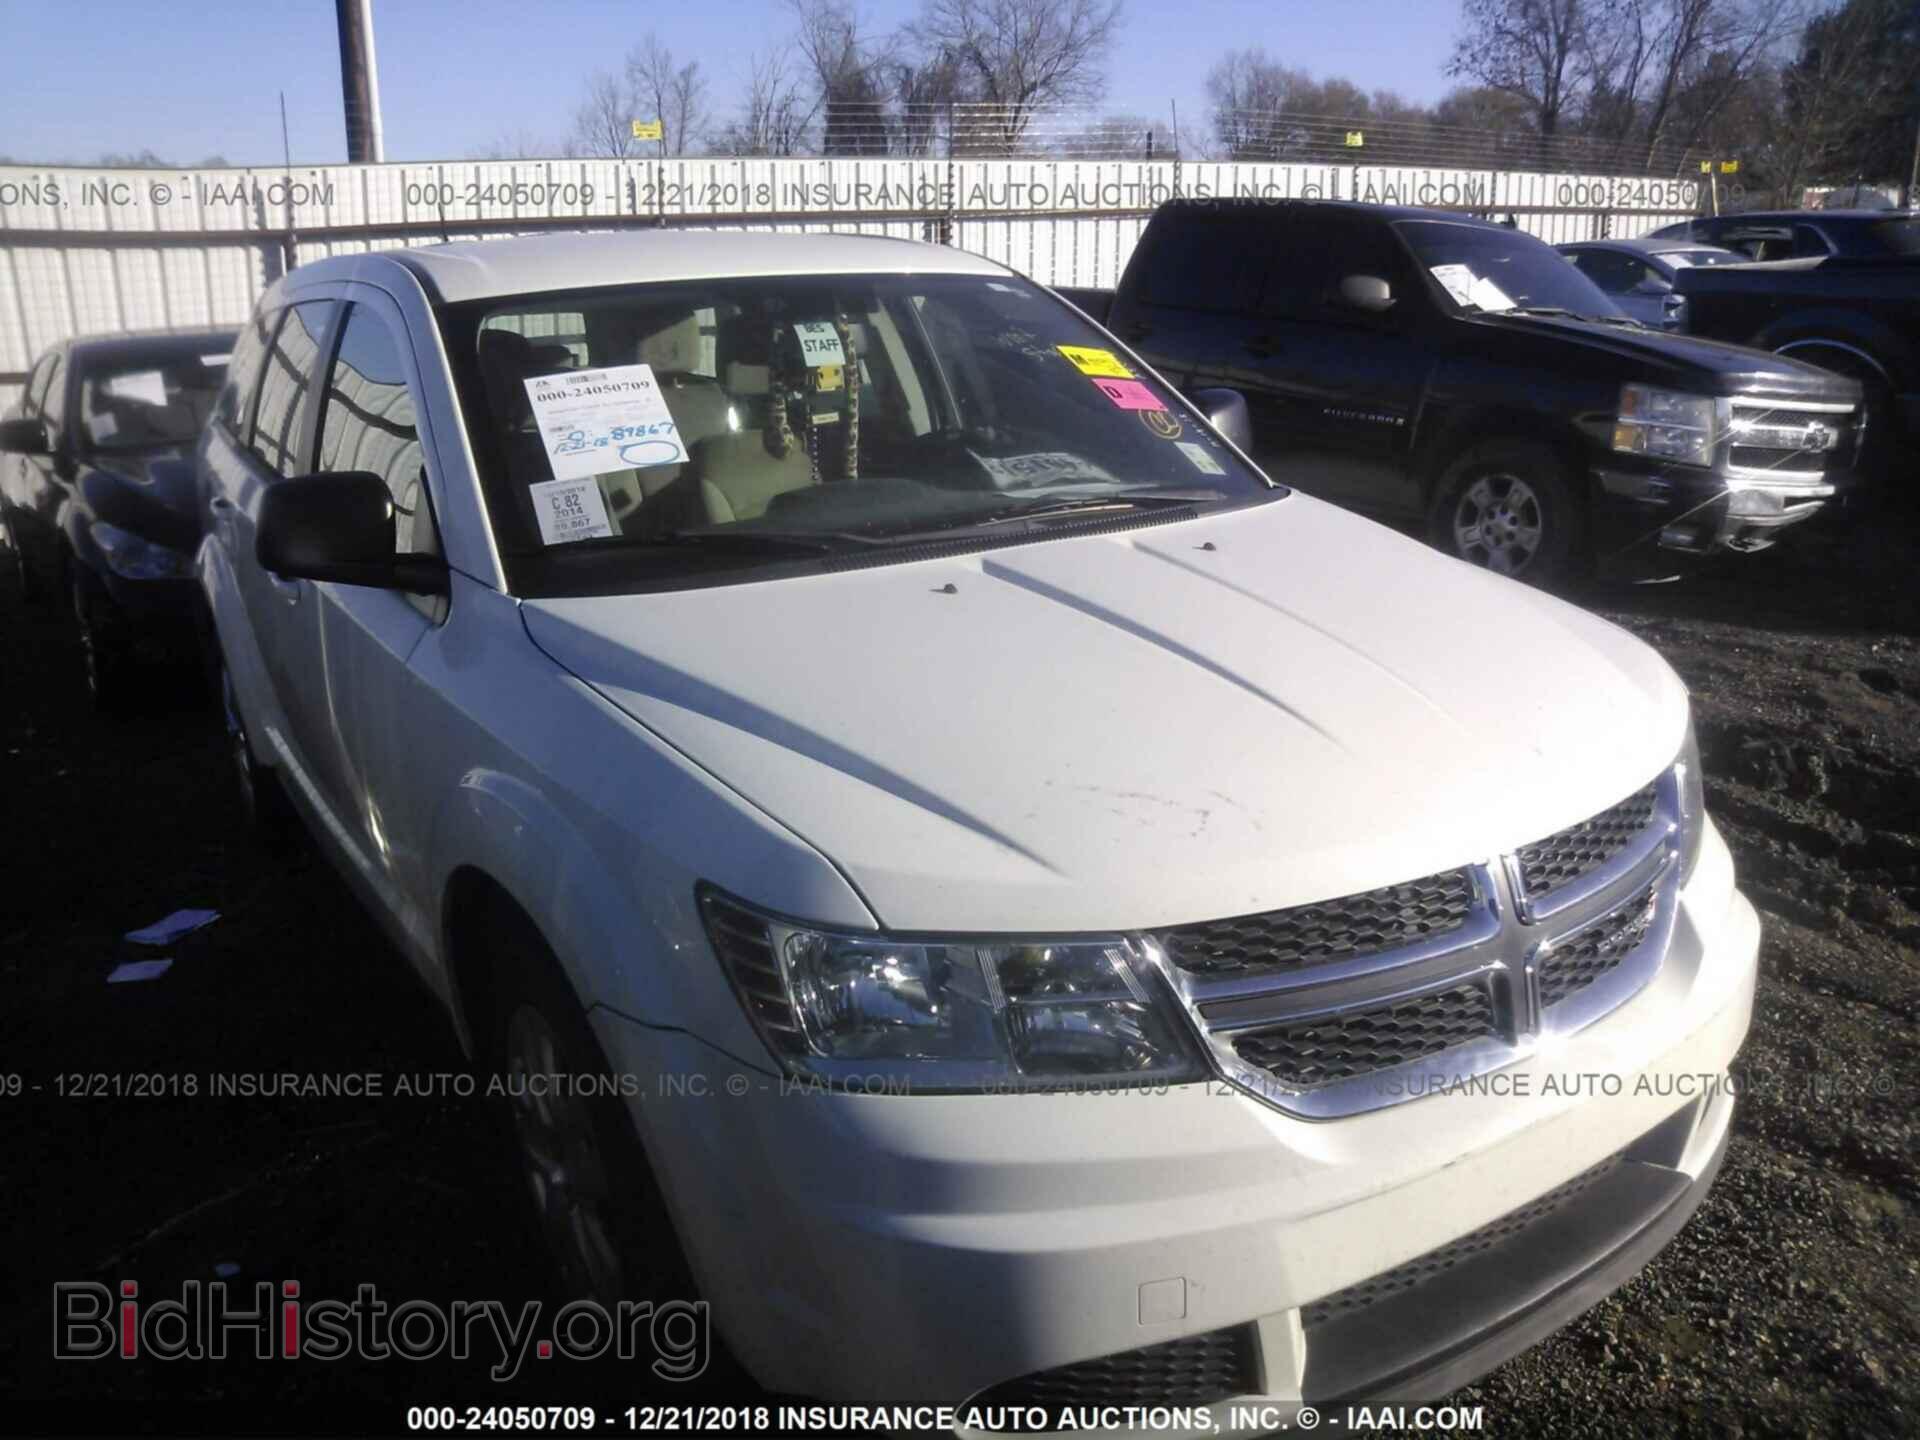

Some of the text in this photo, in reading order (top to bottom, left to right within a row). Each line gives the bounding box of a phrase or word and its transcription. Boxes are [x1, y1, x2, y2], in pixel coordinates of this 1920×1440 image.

[803, 338, 840, 353] STAFF
[536, 380, 650, 403] 000-24050709
[564, 493, 580, 508] 82
